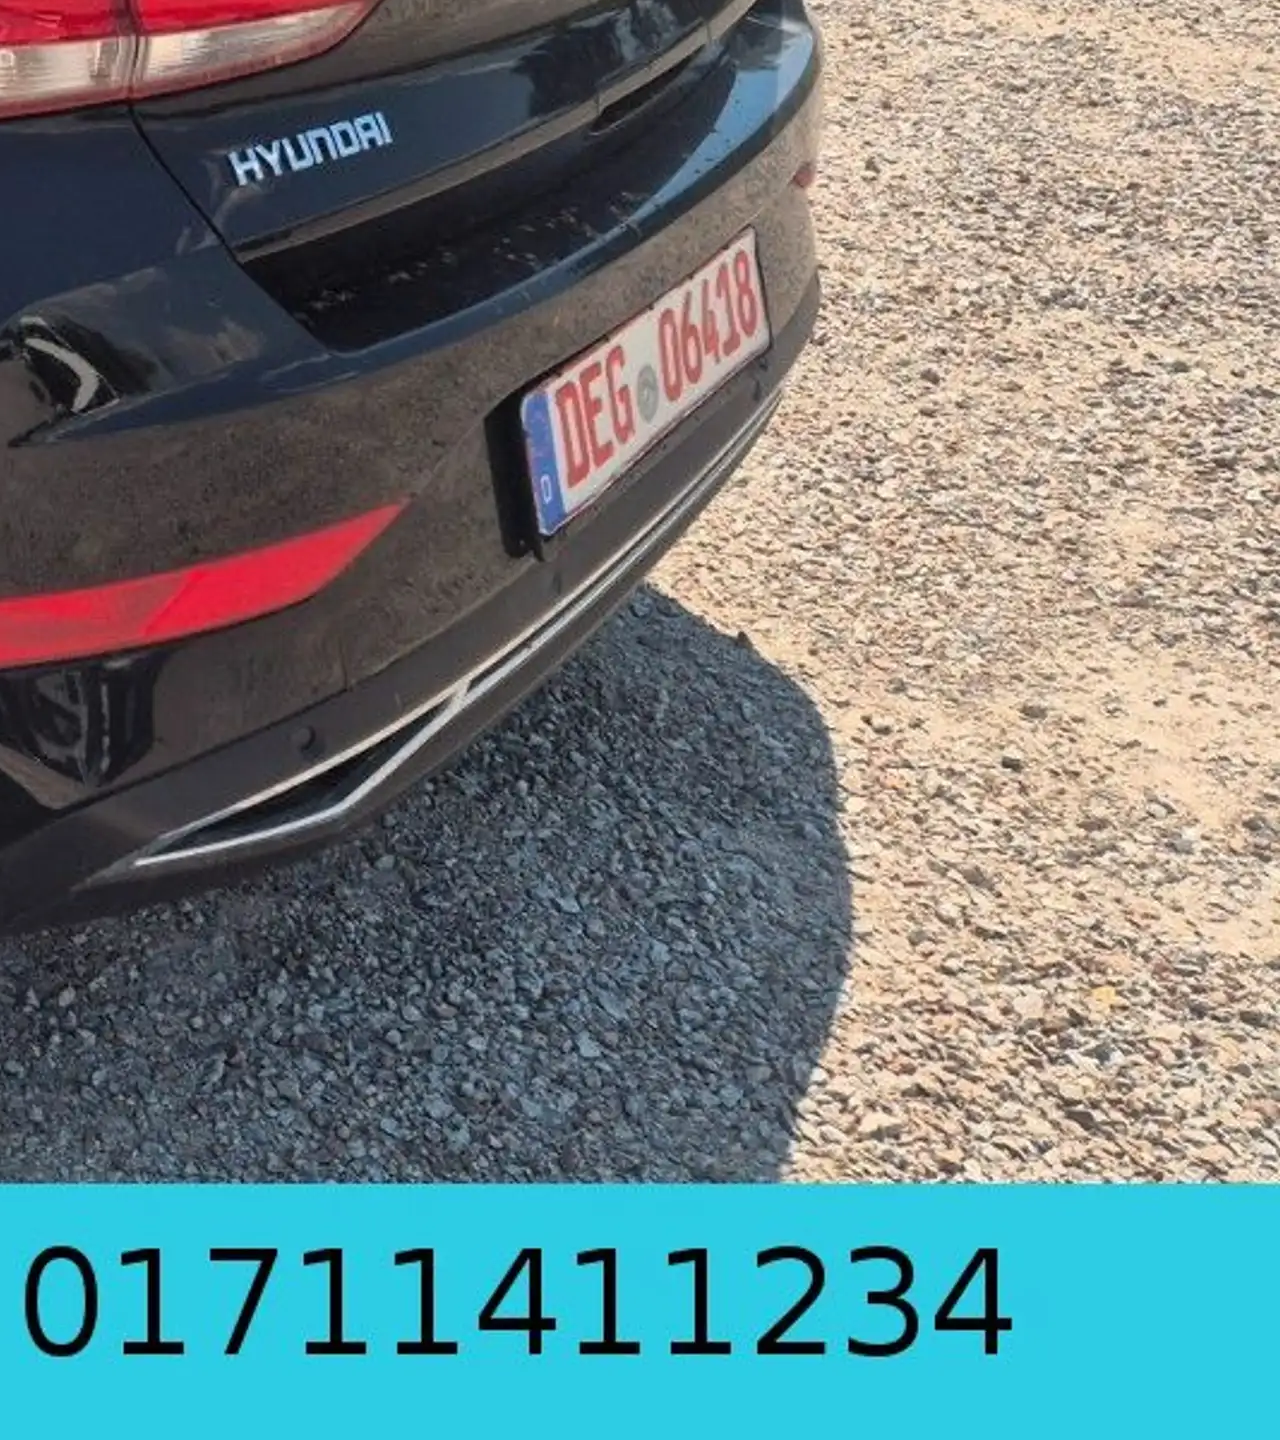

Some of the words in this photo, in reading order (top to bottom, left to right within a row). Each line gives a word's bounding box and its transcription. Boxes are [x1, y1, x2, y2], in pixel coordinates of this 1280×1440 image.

[227, 111, 393, 187] HYUNDAI
[555, 345, 635, 489] DEG
[657, 250, 757, 402] 06418
[540, 474, 553, 504] D
